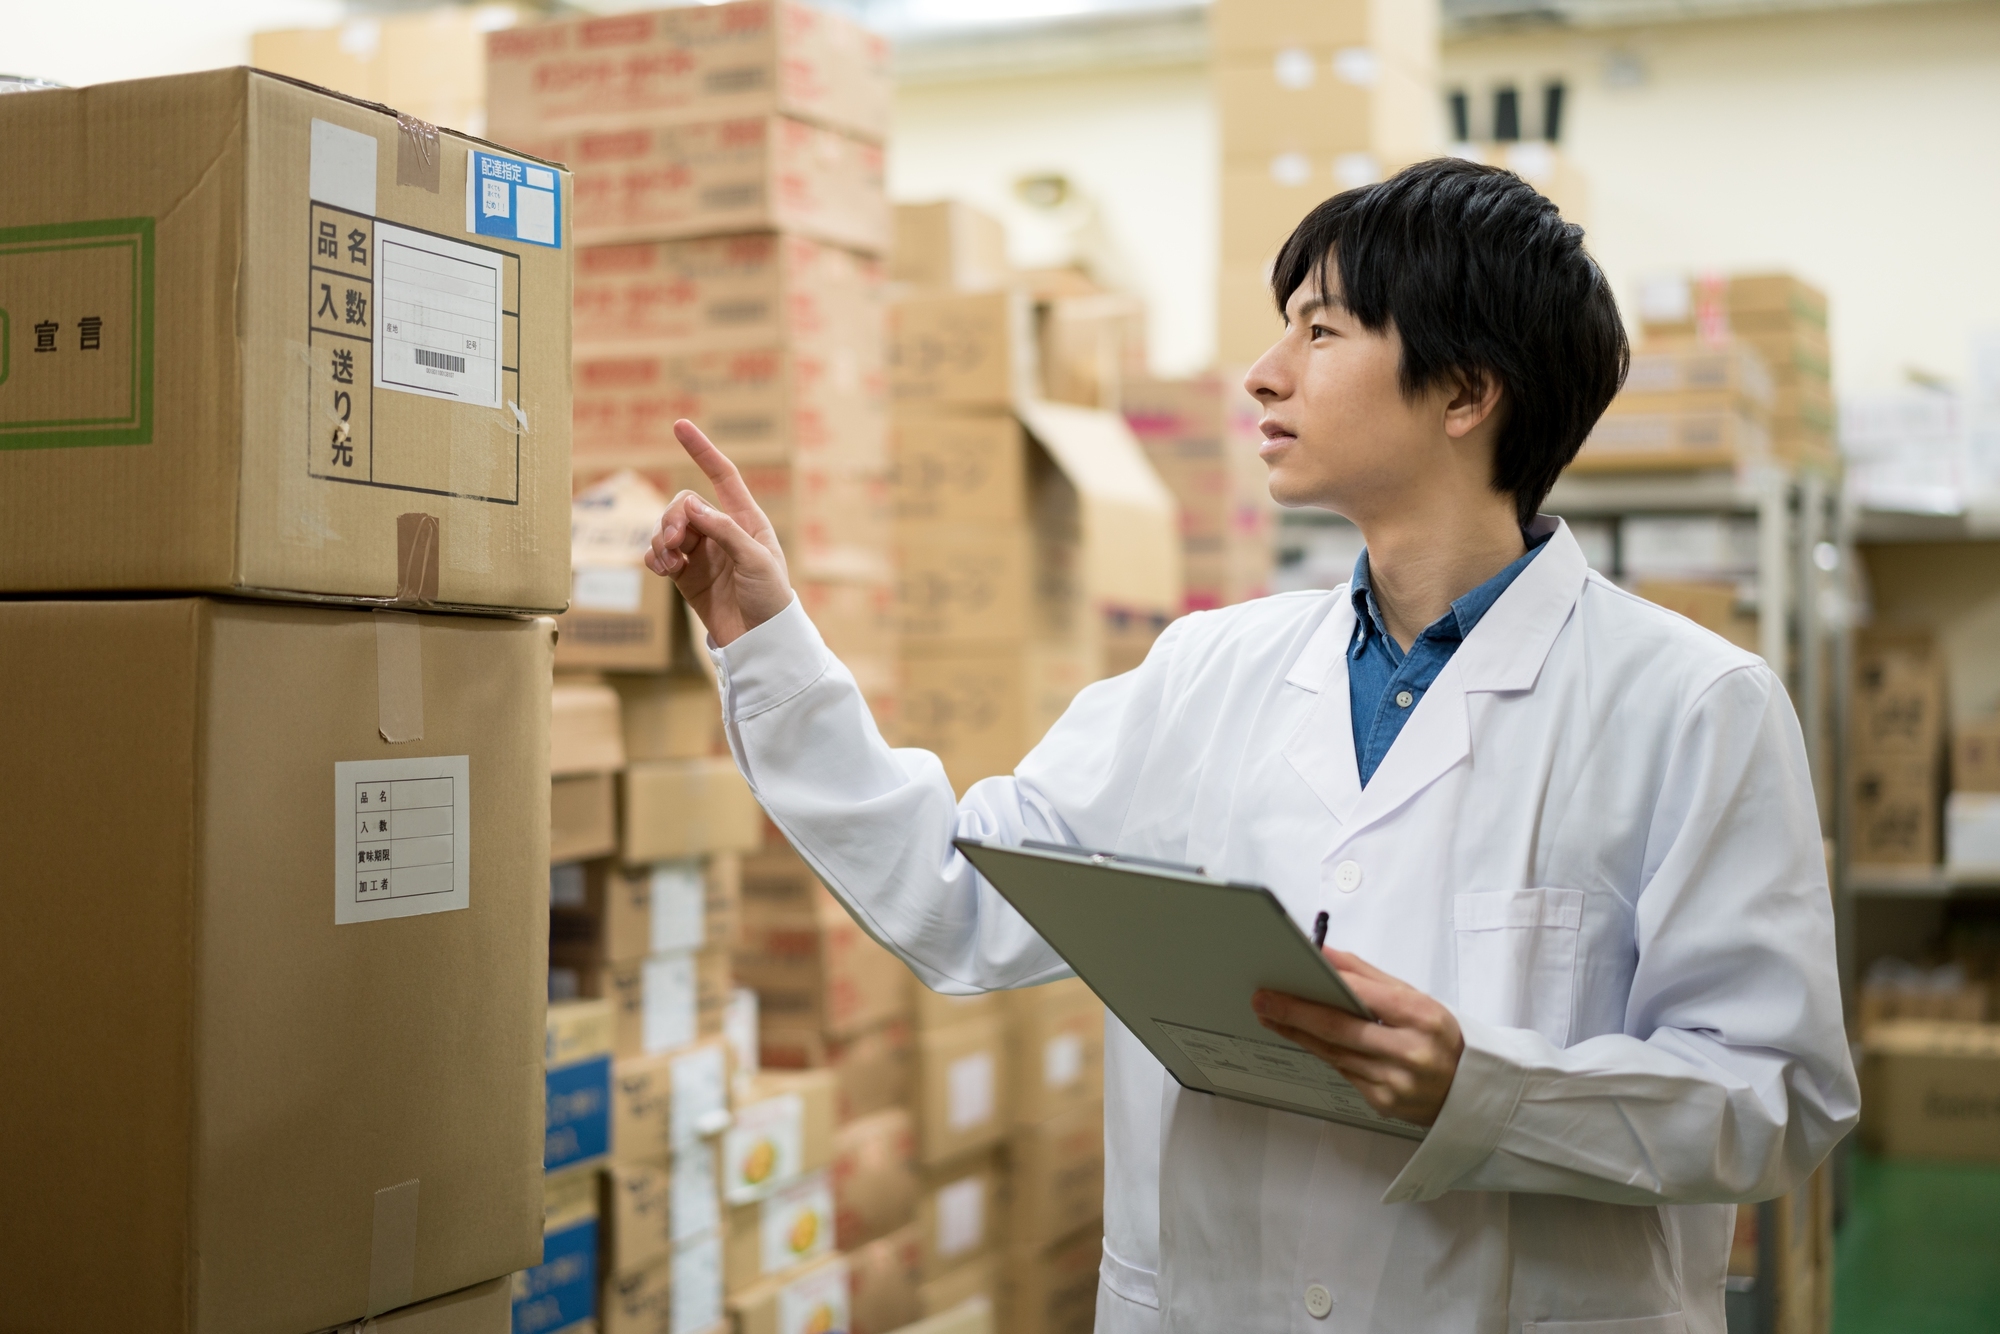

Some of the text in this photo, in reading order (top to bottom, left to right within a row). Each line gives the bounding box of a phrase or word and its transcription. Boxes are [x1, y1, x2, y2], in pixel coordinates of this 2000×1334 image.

[481, 157, 522, 183] 配達指定
[318, 221, 367, 266] 品名
[317, 283, 367, 328] 入数
[466, 339, 478, 351] 記号
[357, 849, 390, 864] 賞味期限
[359, 878, 389, 893] 加工者
